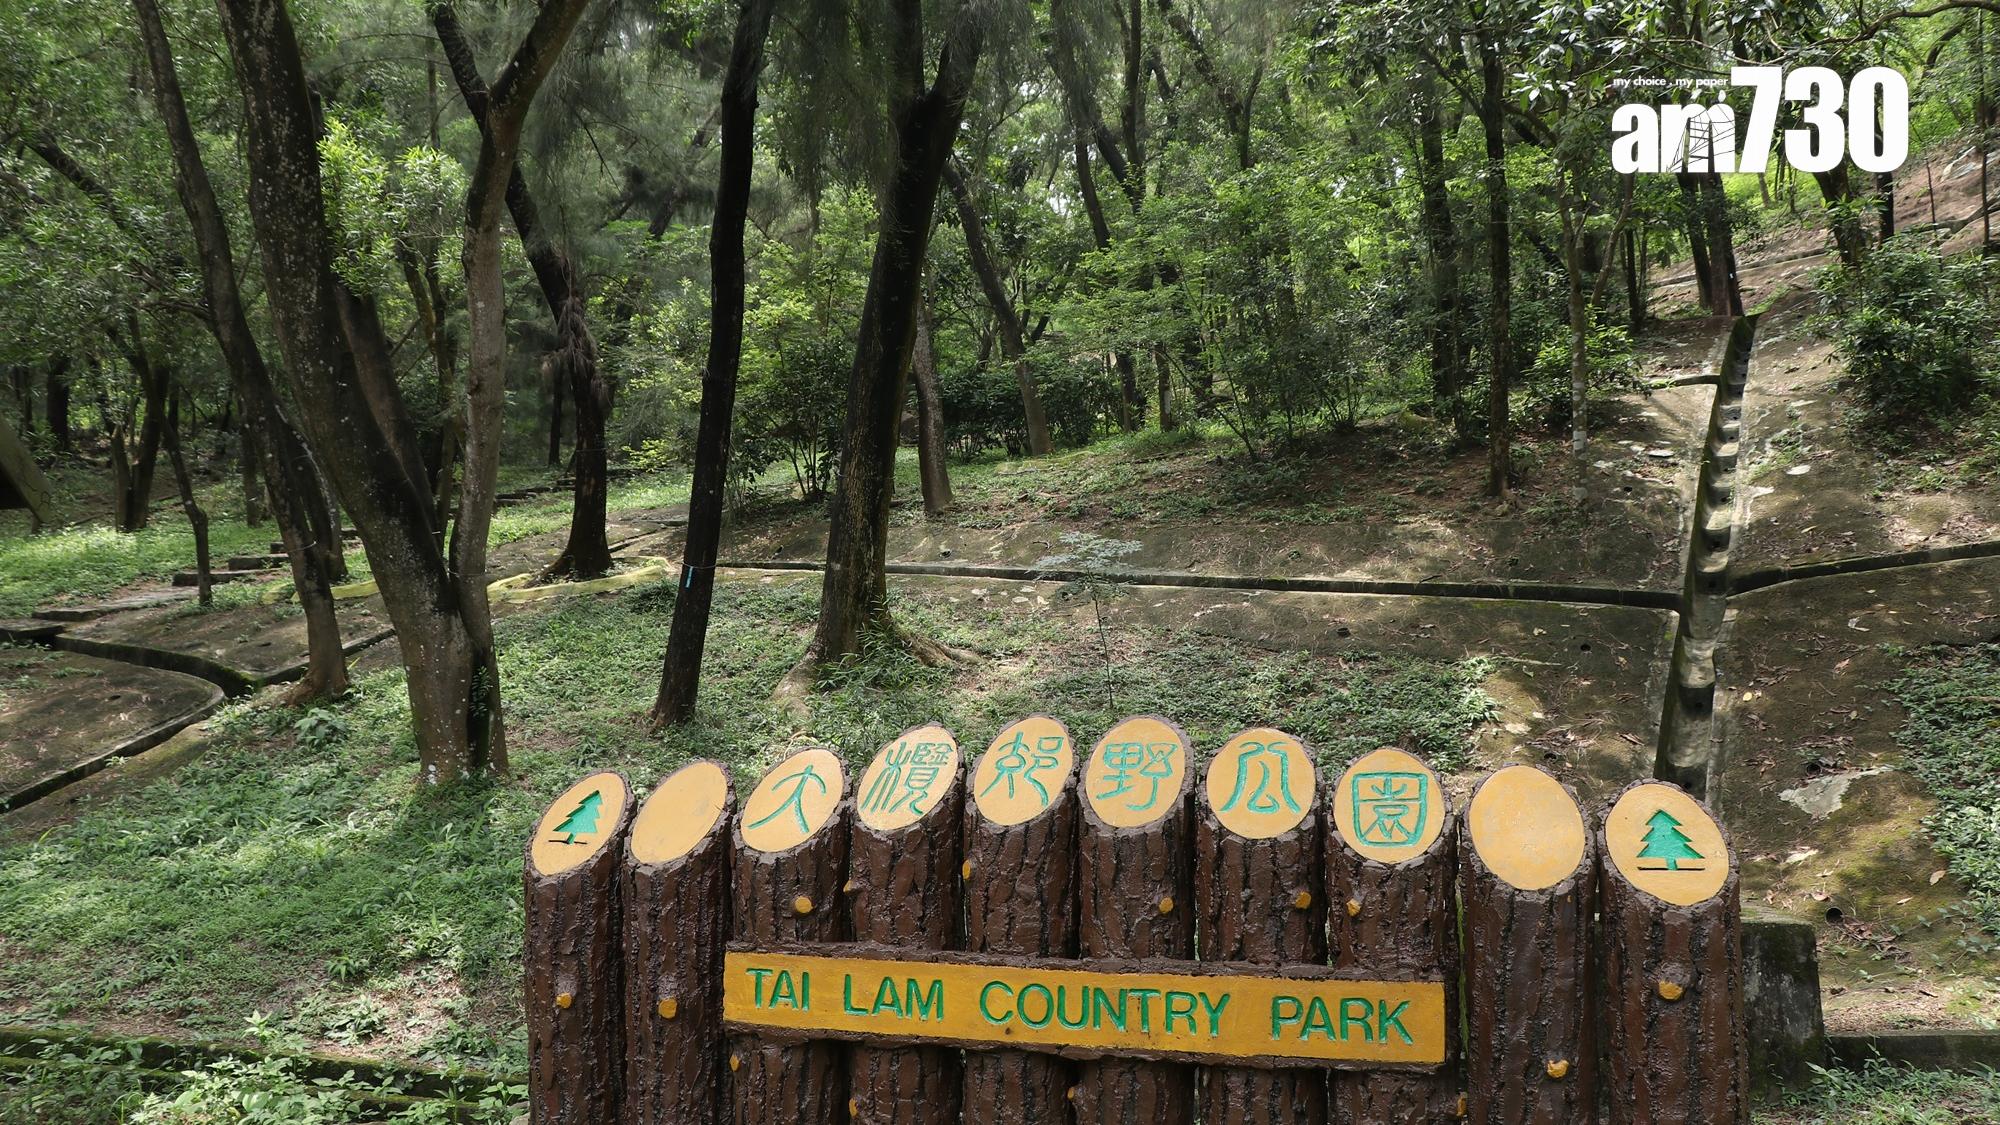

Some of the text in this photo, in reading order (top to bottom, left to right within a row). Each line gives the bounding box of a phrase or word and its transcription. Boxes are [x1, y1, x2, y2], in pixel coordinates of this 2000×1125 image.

[746, 968, 1413, 1044] TAI LAM COUNTRY PARK
